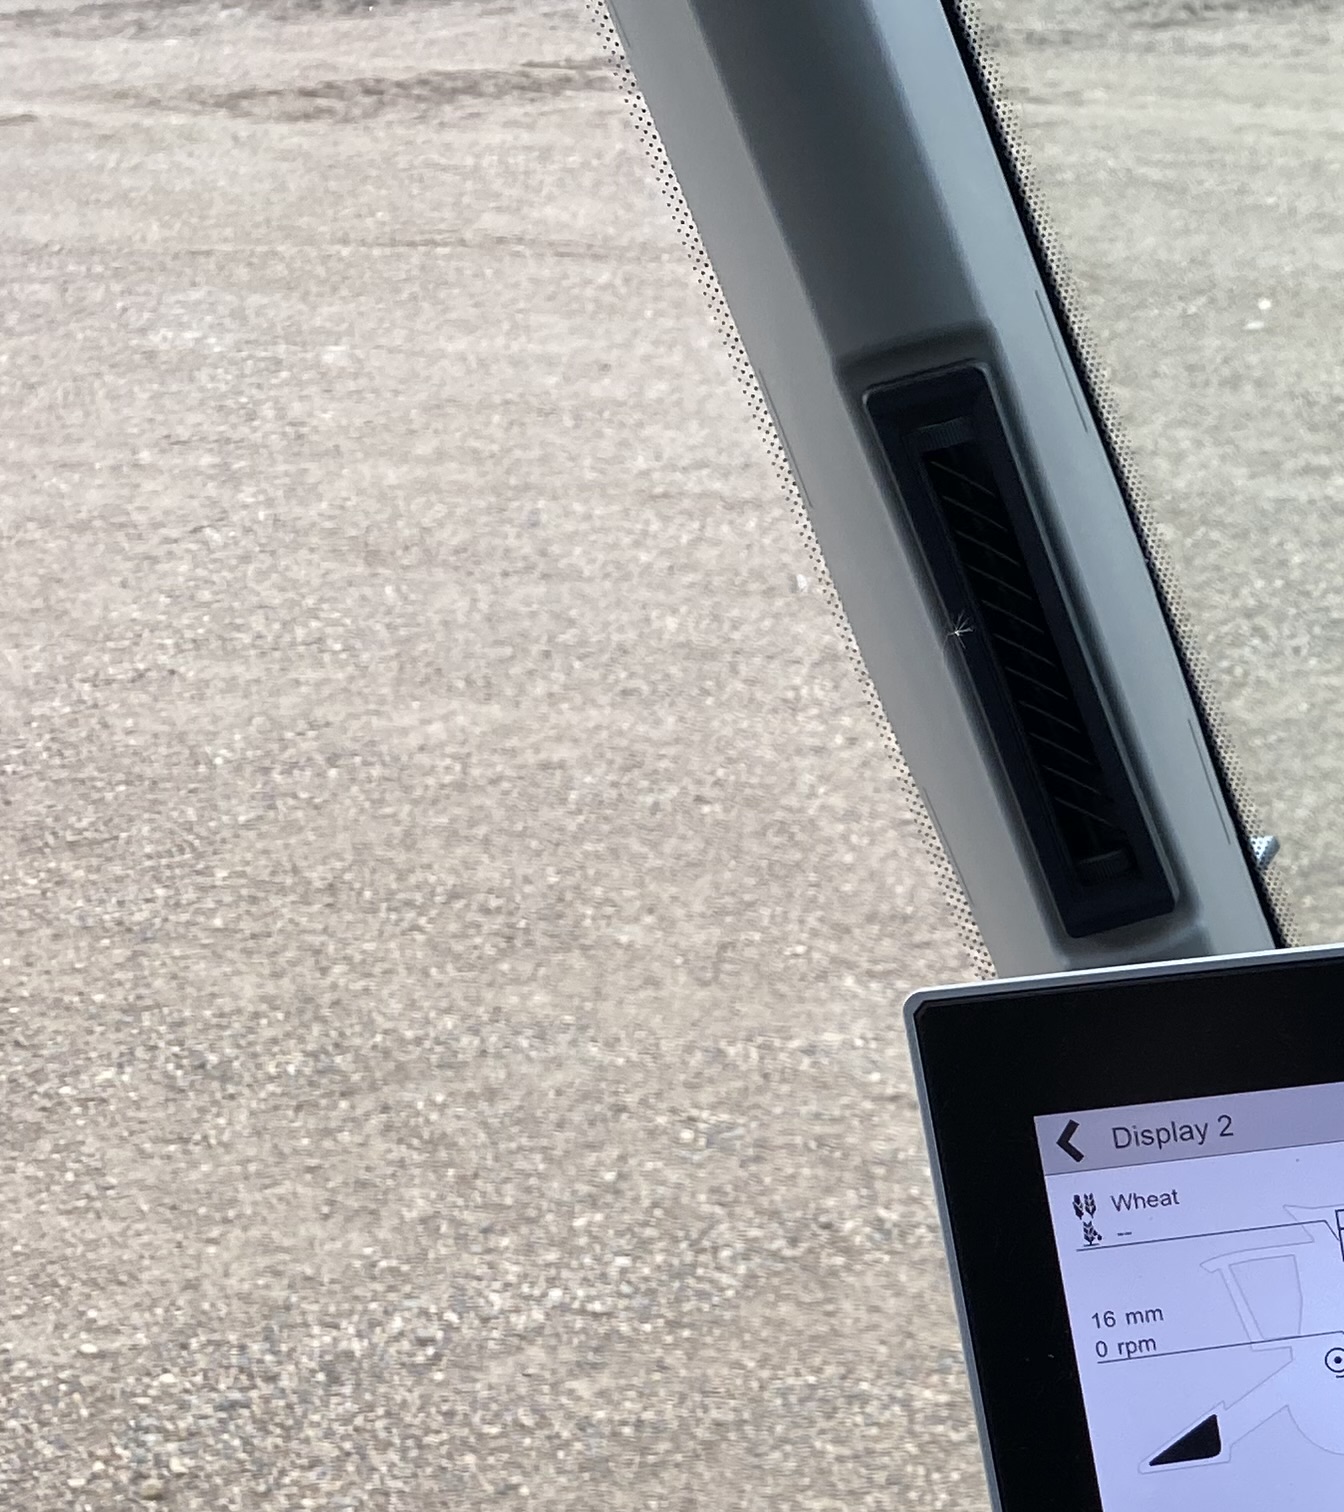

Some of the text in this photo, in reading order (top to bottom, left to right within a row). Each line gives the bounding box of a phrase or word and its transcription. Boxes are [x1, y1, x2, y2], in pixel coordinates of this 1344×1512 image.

[1112, 1115, 1234, 1150] Display 2
[1111, 1189, 1180, 1212] Wheat
[1091, 1307, 1164, 1329] 16 mm
[1095, 1337, 1157, 1358] 0 rpm
